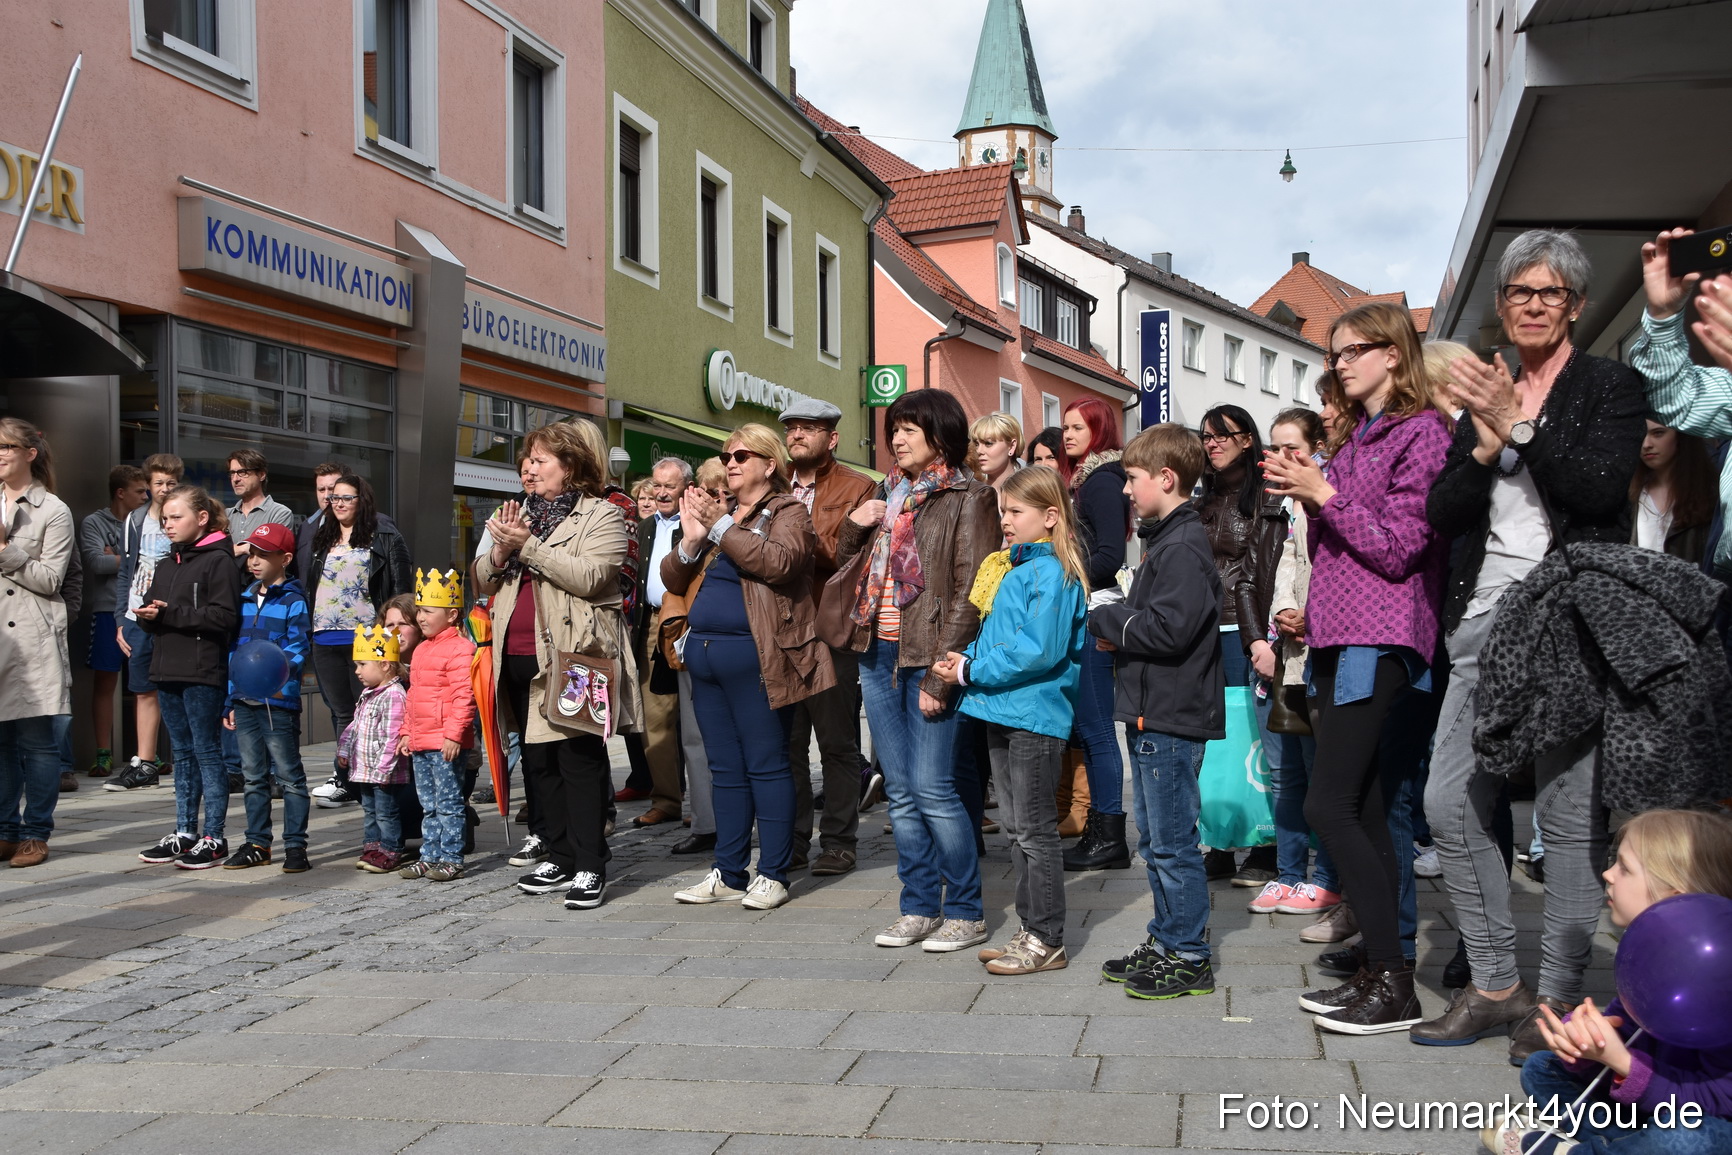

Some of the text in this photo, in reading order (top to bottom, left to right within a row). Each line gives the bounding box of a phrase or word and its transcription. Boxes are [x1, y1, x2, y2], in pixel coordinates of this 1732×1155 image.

[207, 216, 411, 312] KOMMUNIKATION
[463, 300, 605, 372] BÜROELEKTRONIK
[1160, 322, 1168, 424] OM TAILOR
